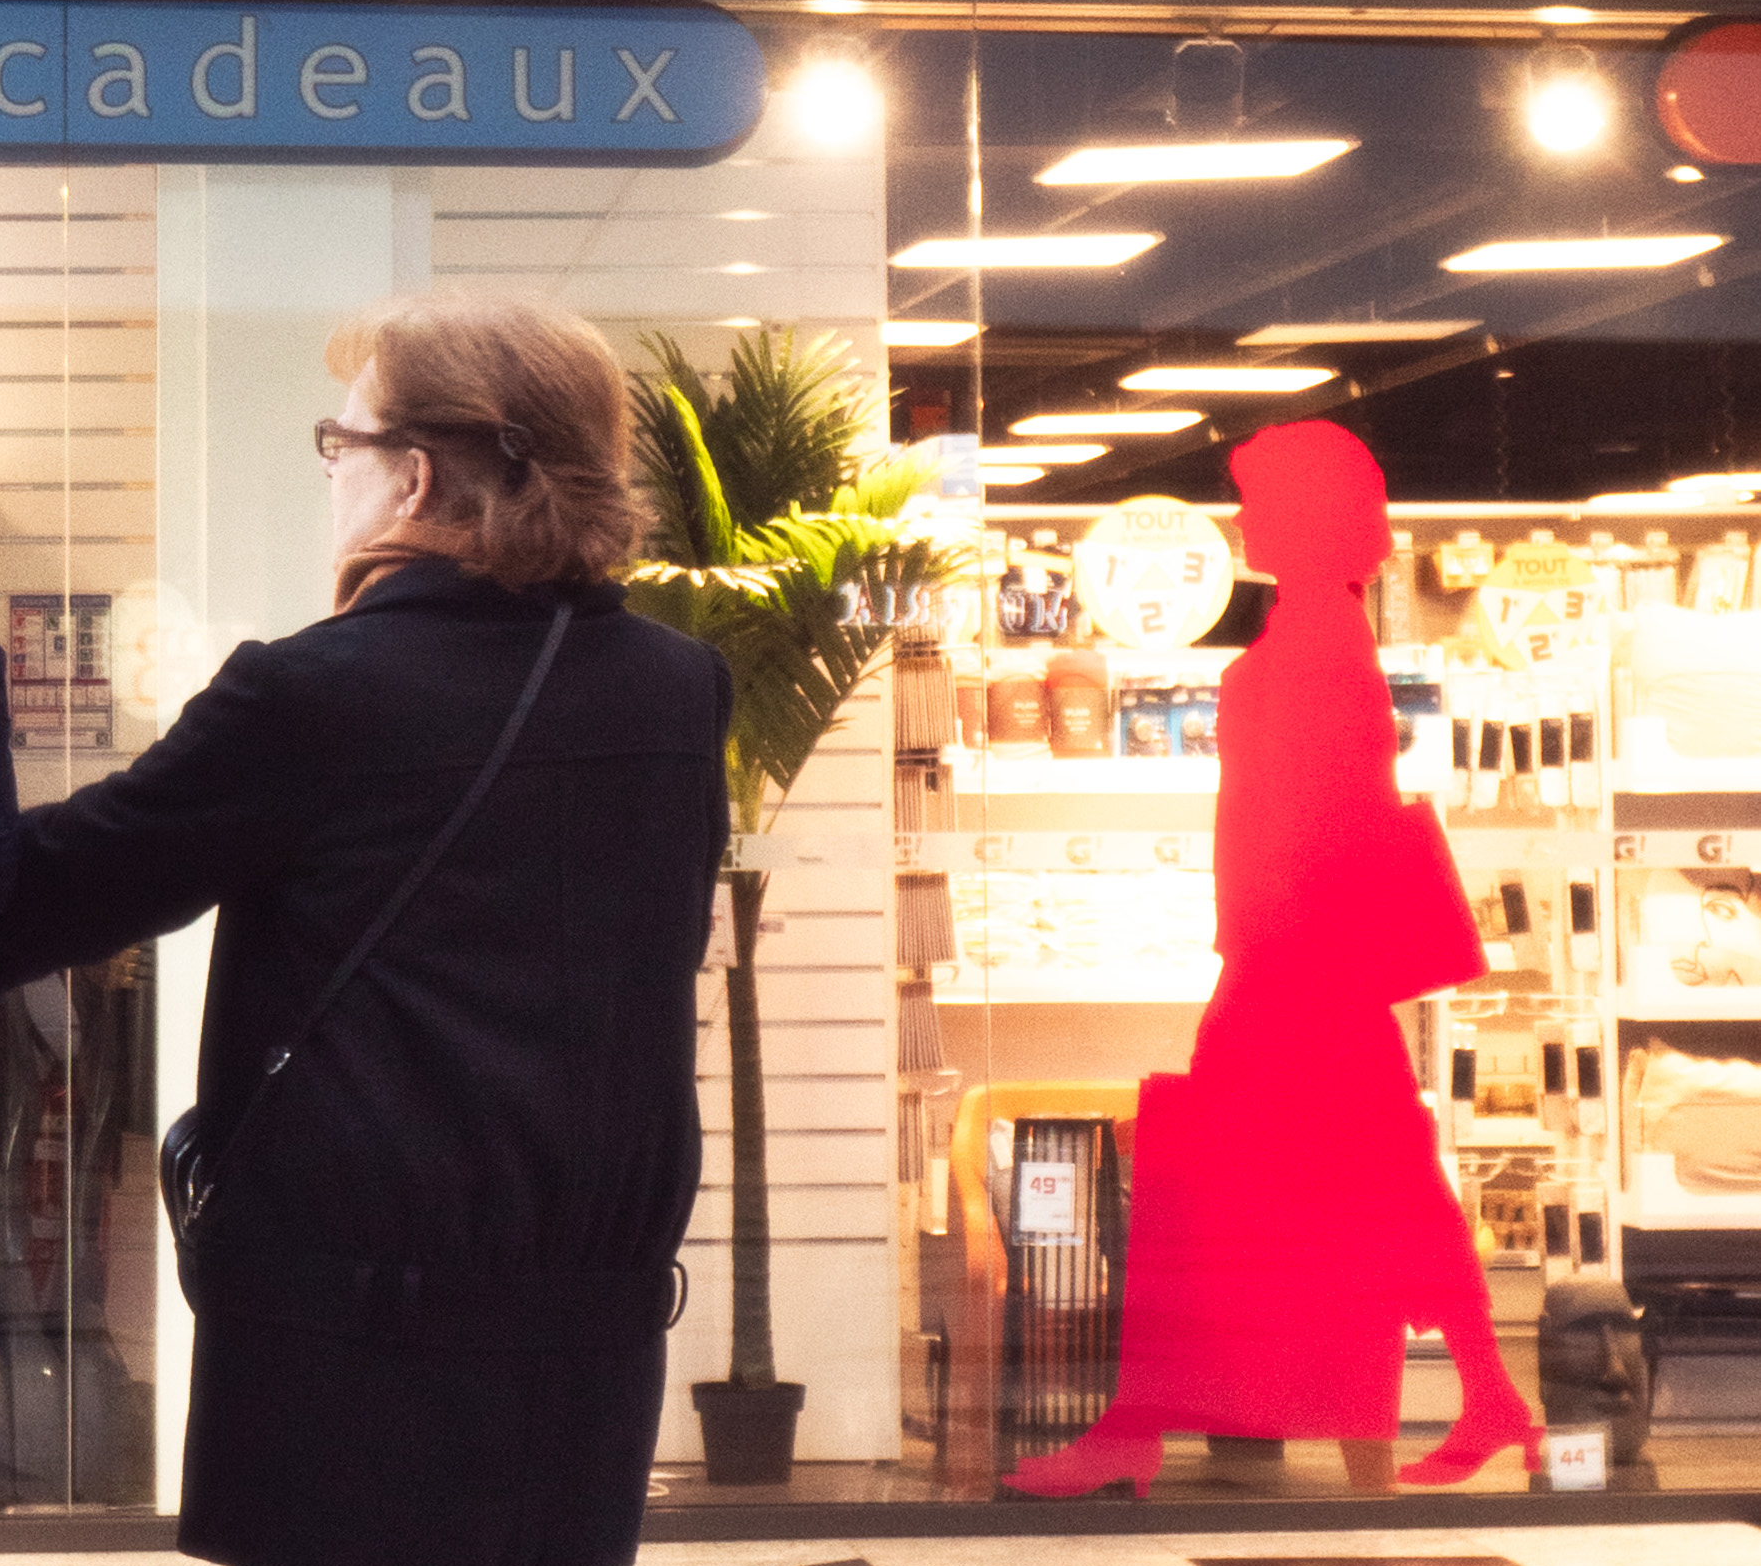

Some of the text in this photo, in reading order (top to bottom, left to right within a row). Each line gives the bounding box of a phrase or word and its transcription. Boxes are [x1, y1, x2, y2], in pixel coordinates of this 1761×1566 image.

[1121, 510, 1189, 531] TOUT
[1512, 558, 1570, 576] TOUT
[1696, 834, 1734, 865] G!
[1029, 1176, 1057, 1195] 49
[1560, 1447, 1586, 1466] 44
